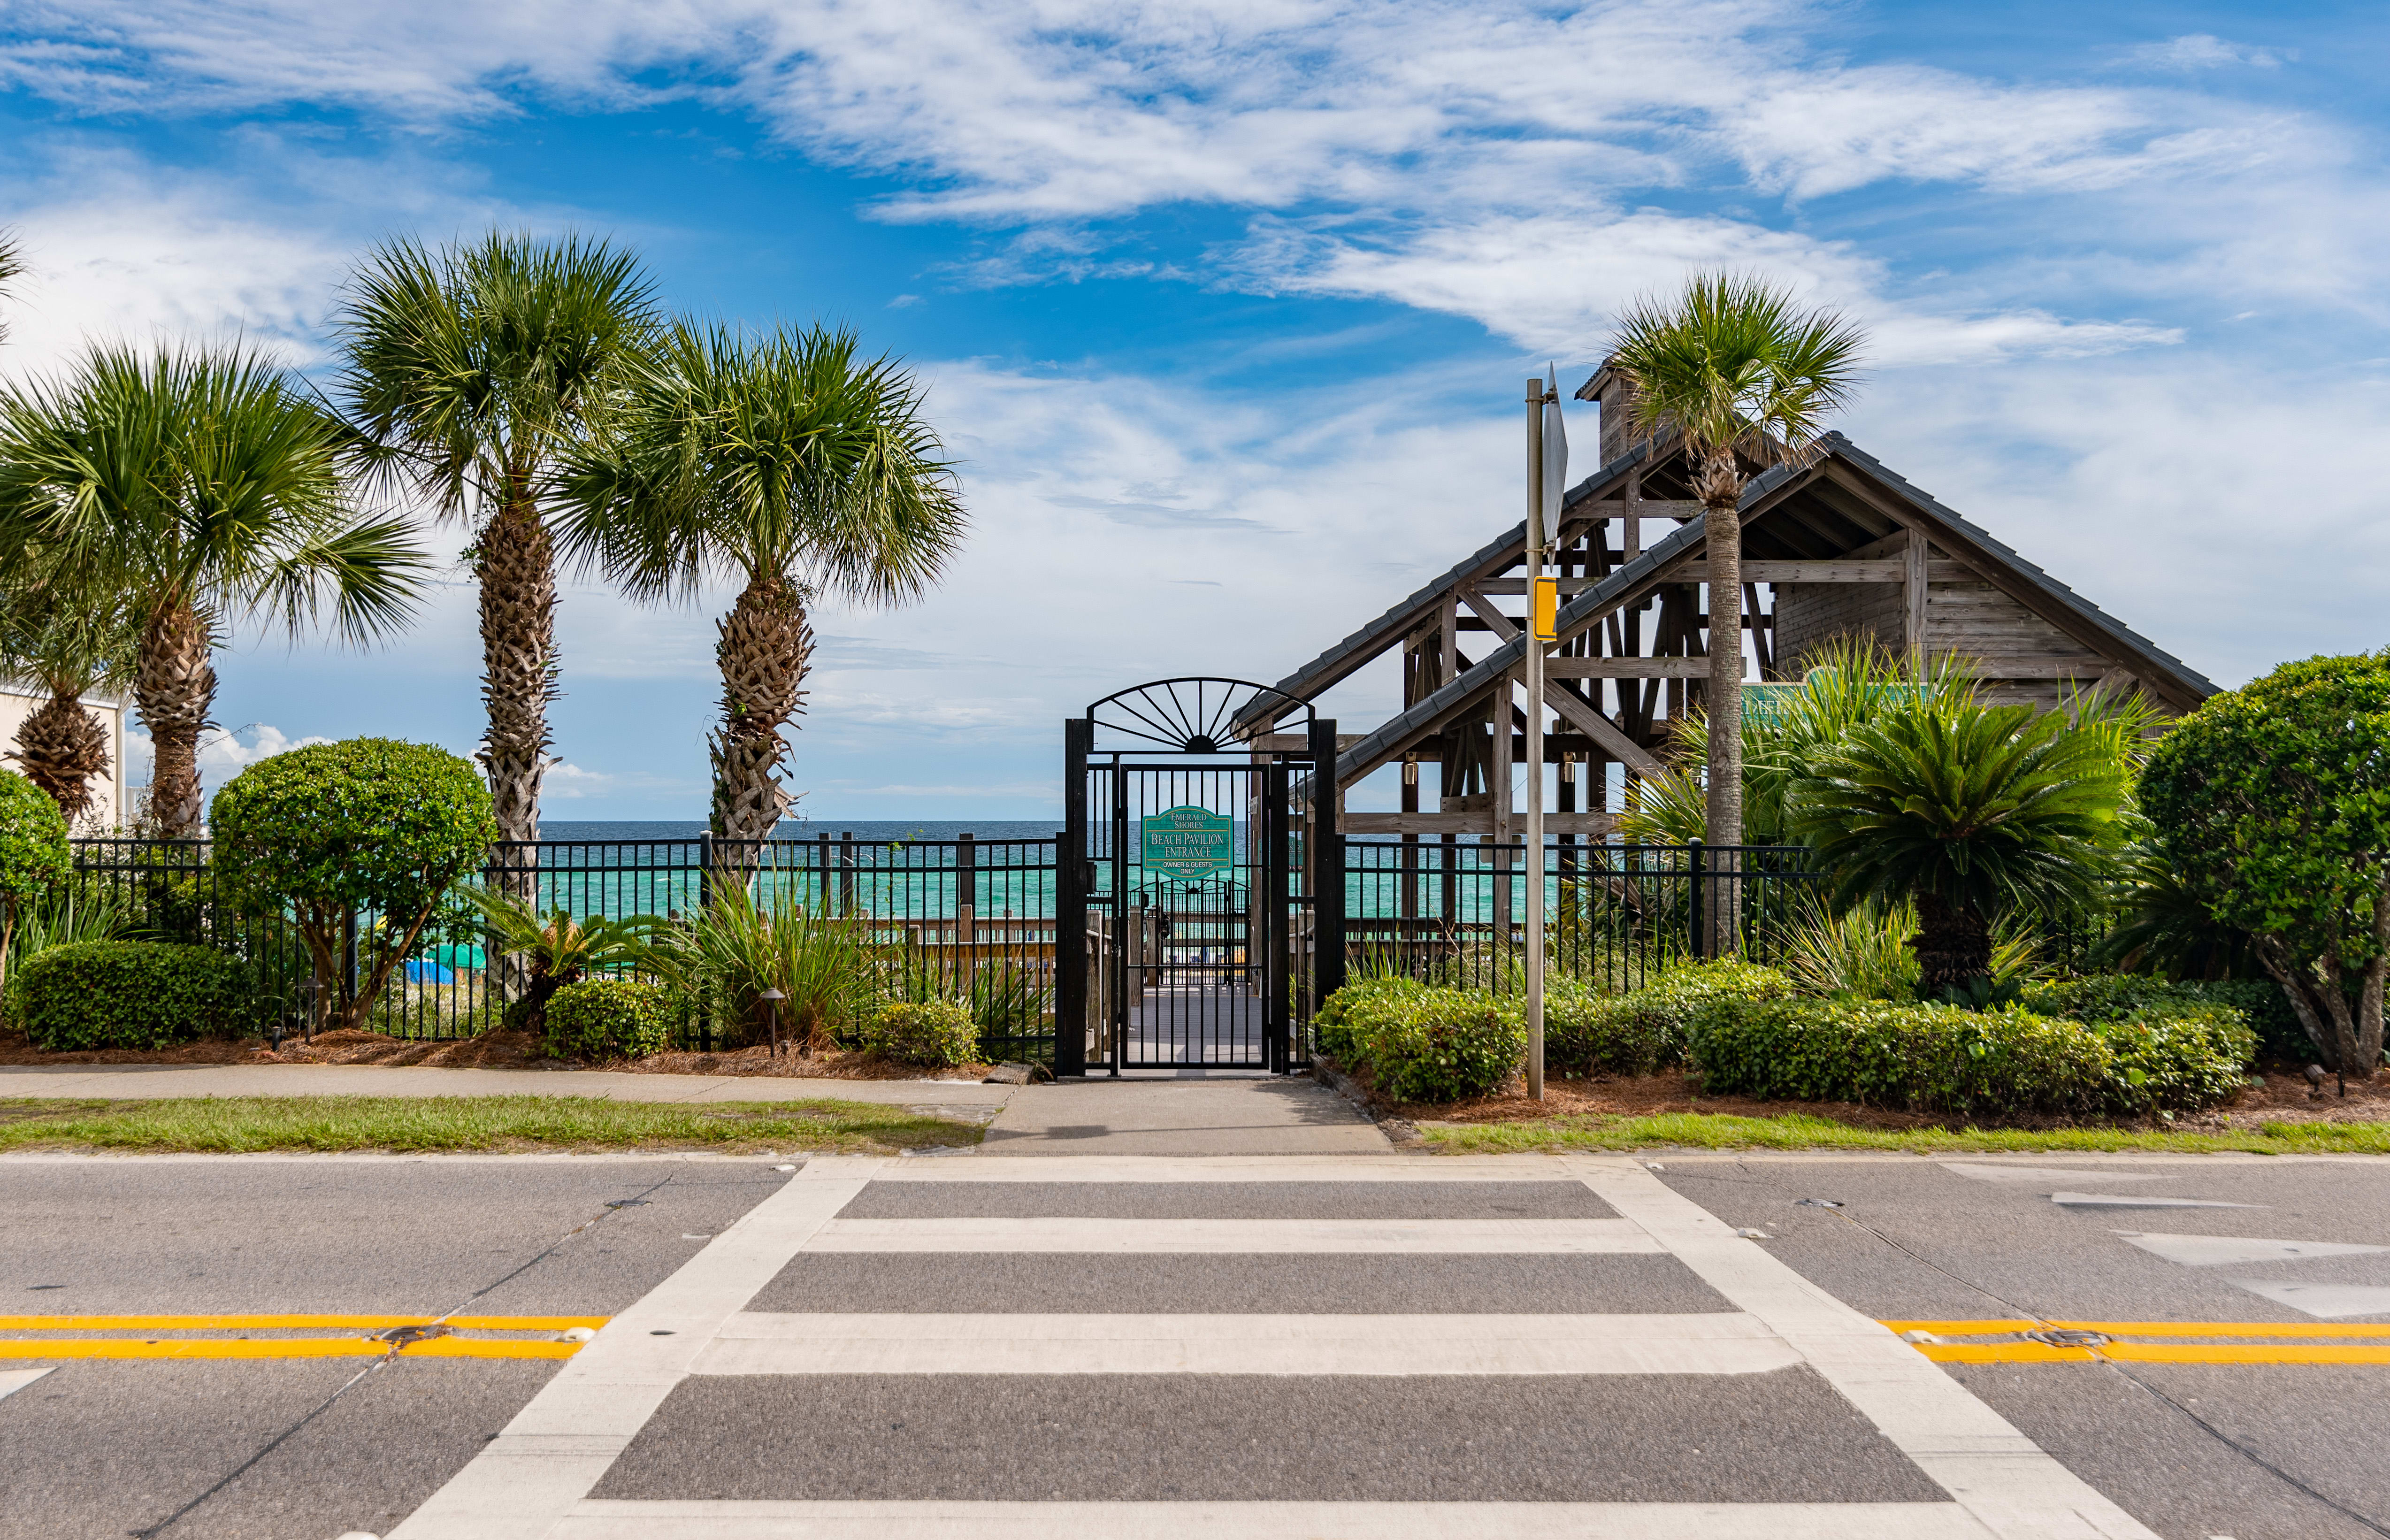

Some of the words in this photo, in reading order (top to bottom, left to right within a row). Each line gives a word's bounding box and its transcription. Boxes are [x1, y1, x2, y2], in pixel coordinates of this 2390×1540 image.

[1151, 833, 1181, 845] BEACH
[1184, 833, 1224, 845] PAVILION
[1165, 846, 1211, 857] ENTRANCE
